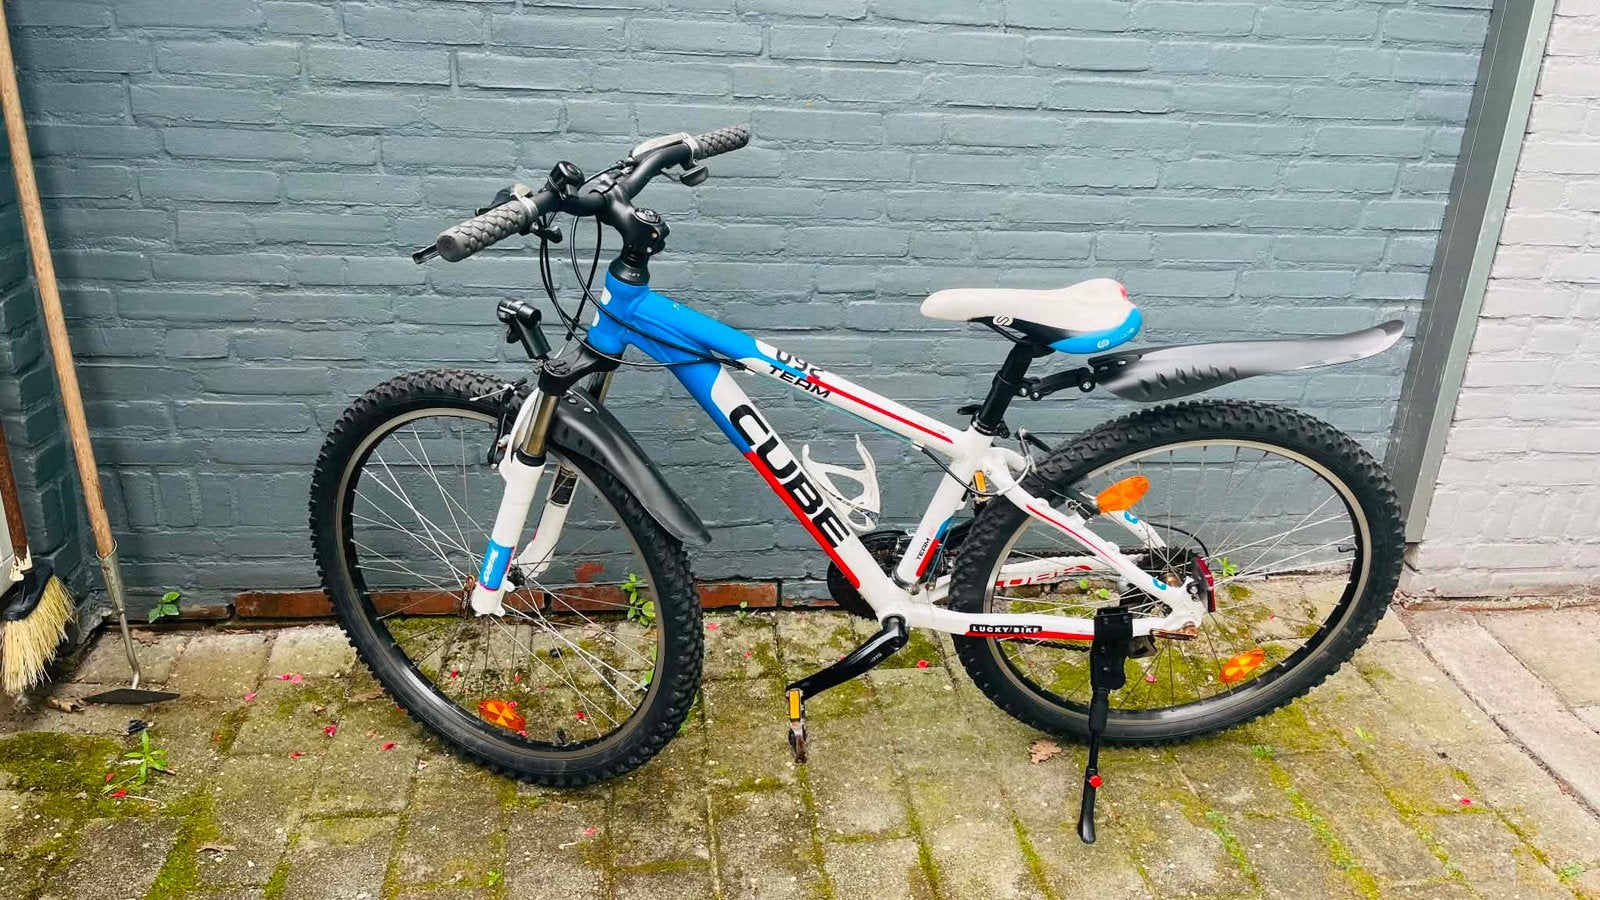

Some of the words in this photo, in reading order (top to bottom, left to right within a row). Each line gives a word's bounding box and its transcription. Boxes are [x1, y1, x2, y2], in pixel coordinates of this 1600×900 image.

[769, 364, 831, 399] TEAM
[729, 404, 850, 549] CUBE
[915, 537, 932, 561] TEAM
